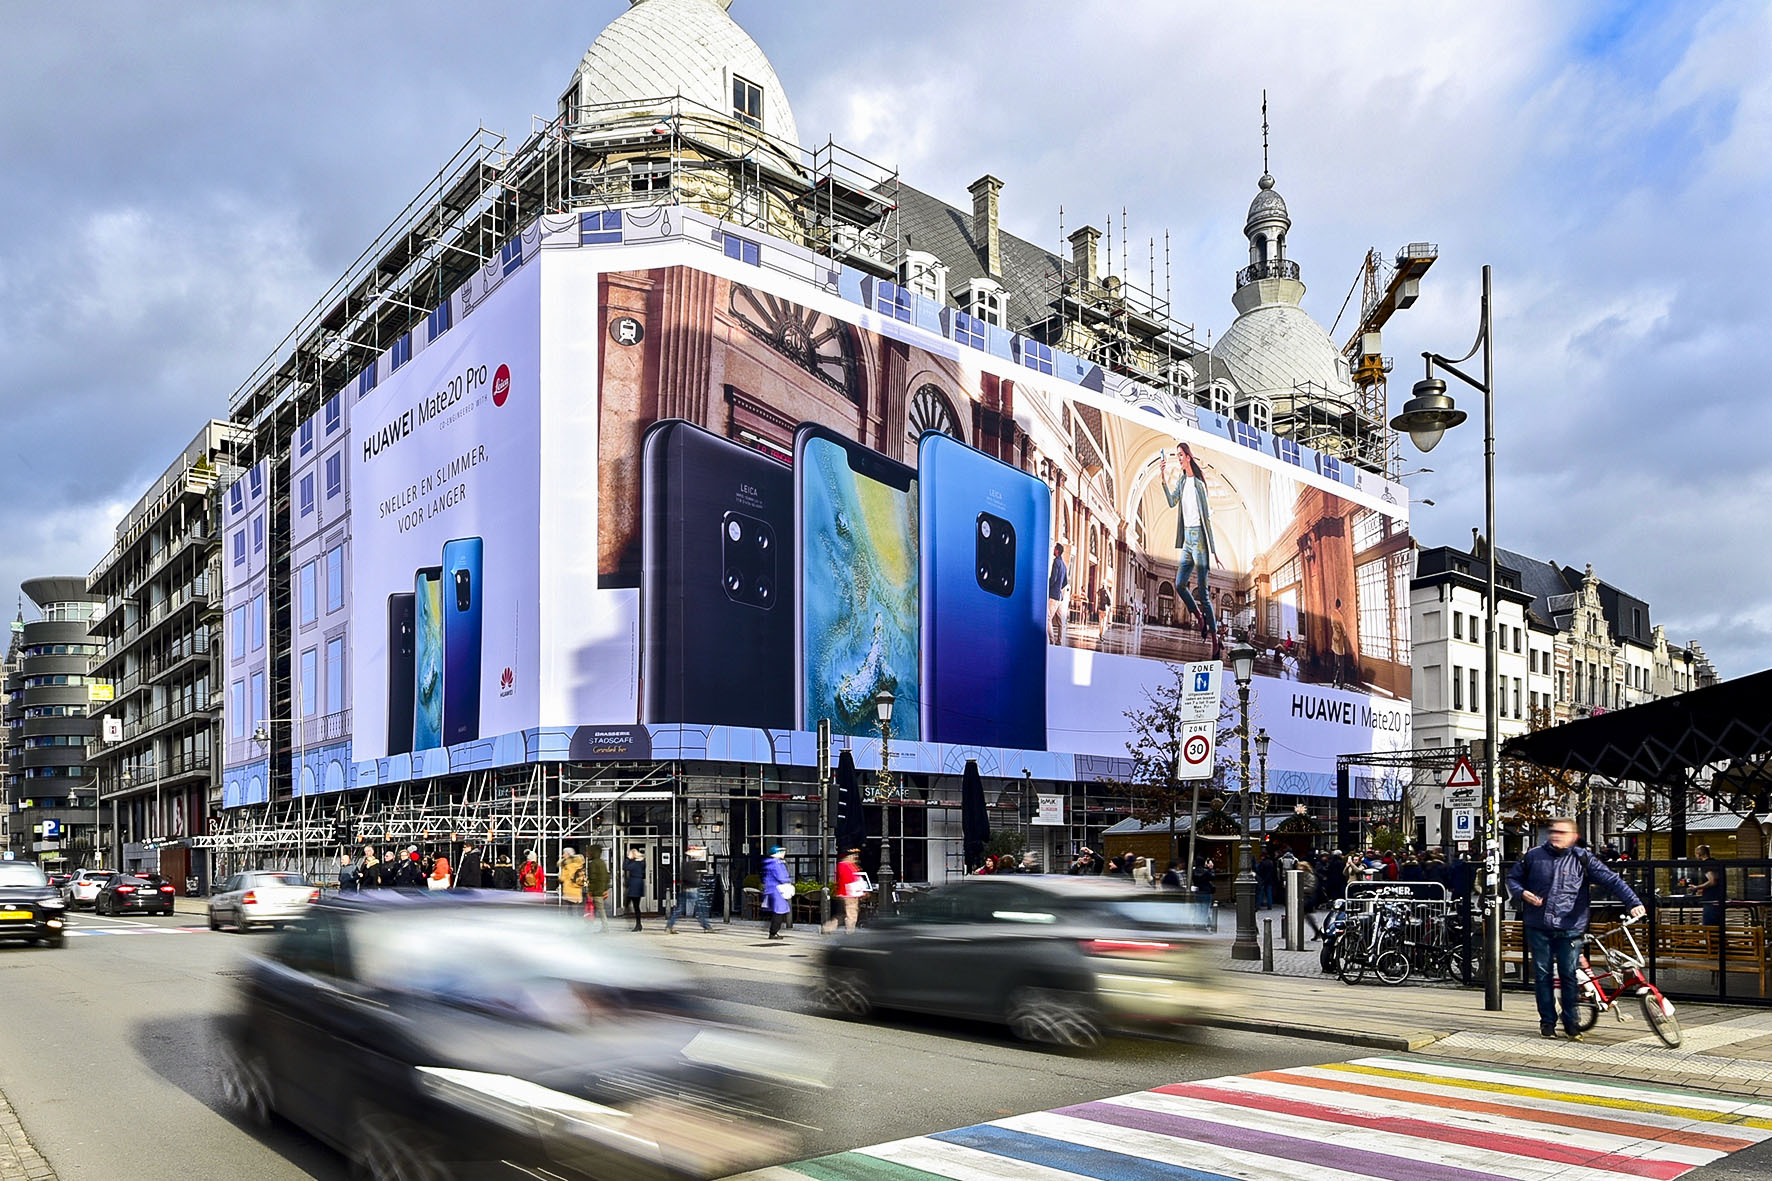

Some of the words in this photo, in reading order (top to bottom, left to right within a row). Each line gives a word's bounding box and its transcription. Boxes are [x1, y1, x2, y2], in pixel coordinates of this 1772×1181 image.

[363, 408, 414, 463] HUAWEI
[418, 375, 463, 427] Mate20
[466, 364, 488, 394] Pro
[379, 484, 418, 519] SNELLER
[421, 475, 433, 497] EN
[436, 444, 490, 487] SLIMMER,
[740, 483, 758, 497] LEICA
[397, 507, 424, 534] VOOR
[427, 483, 466, 520] LANGER
[1192, 664, 1214, 672] ZONE
[1291, 694, 1357, 725] HUAWEI
[1361, 706, 1401, 733] Mate20
[1189, 744, 1204, 755] 30
[43, 820, 56, 837] P
